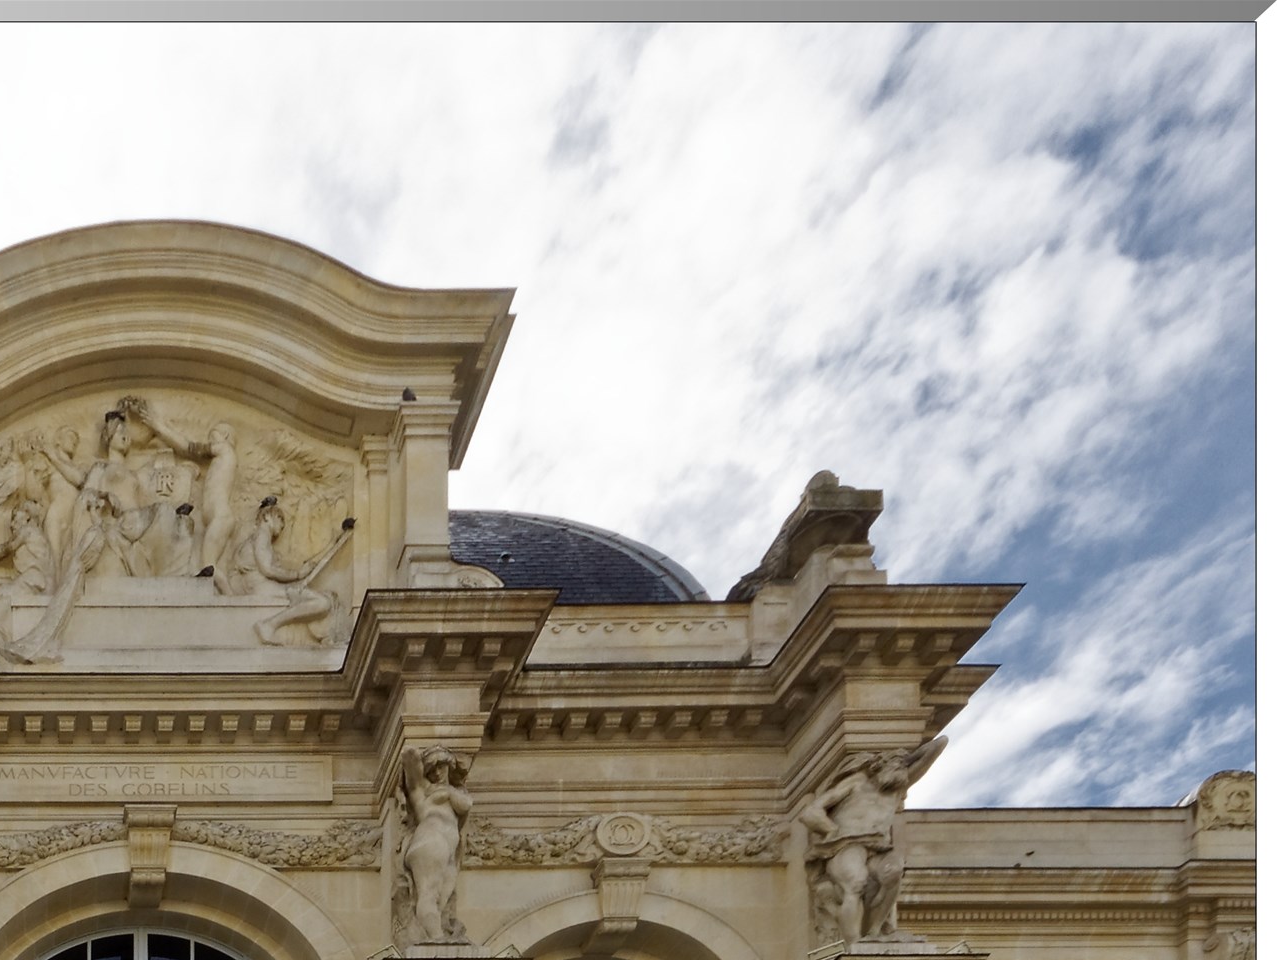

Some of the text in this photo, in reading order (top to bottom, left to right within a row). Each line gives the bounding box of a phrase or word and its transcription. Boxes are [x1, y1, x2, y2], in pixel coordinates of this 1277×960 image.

[179, 765, 298, 780] NATIONALE
[68, 782, 231, 797] DES GOBELINS
